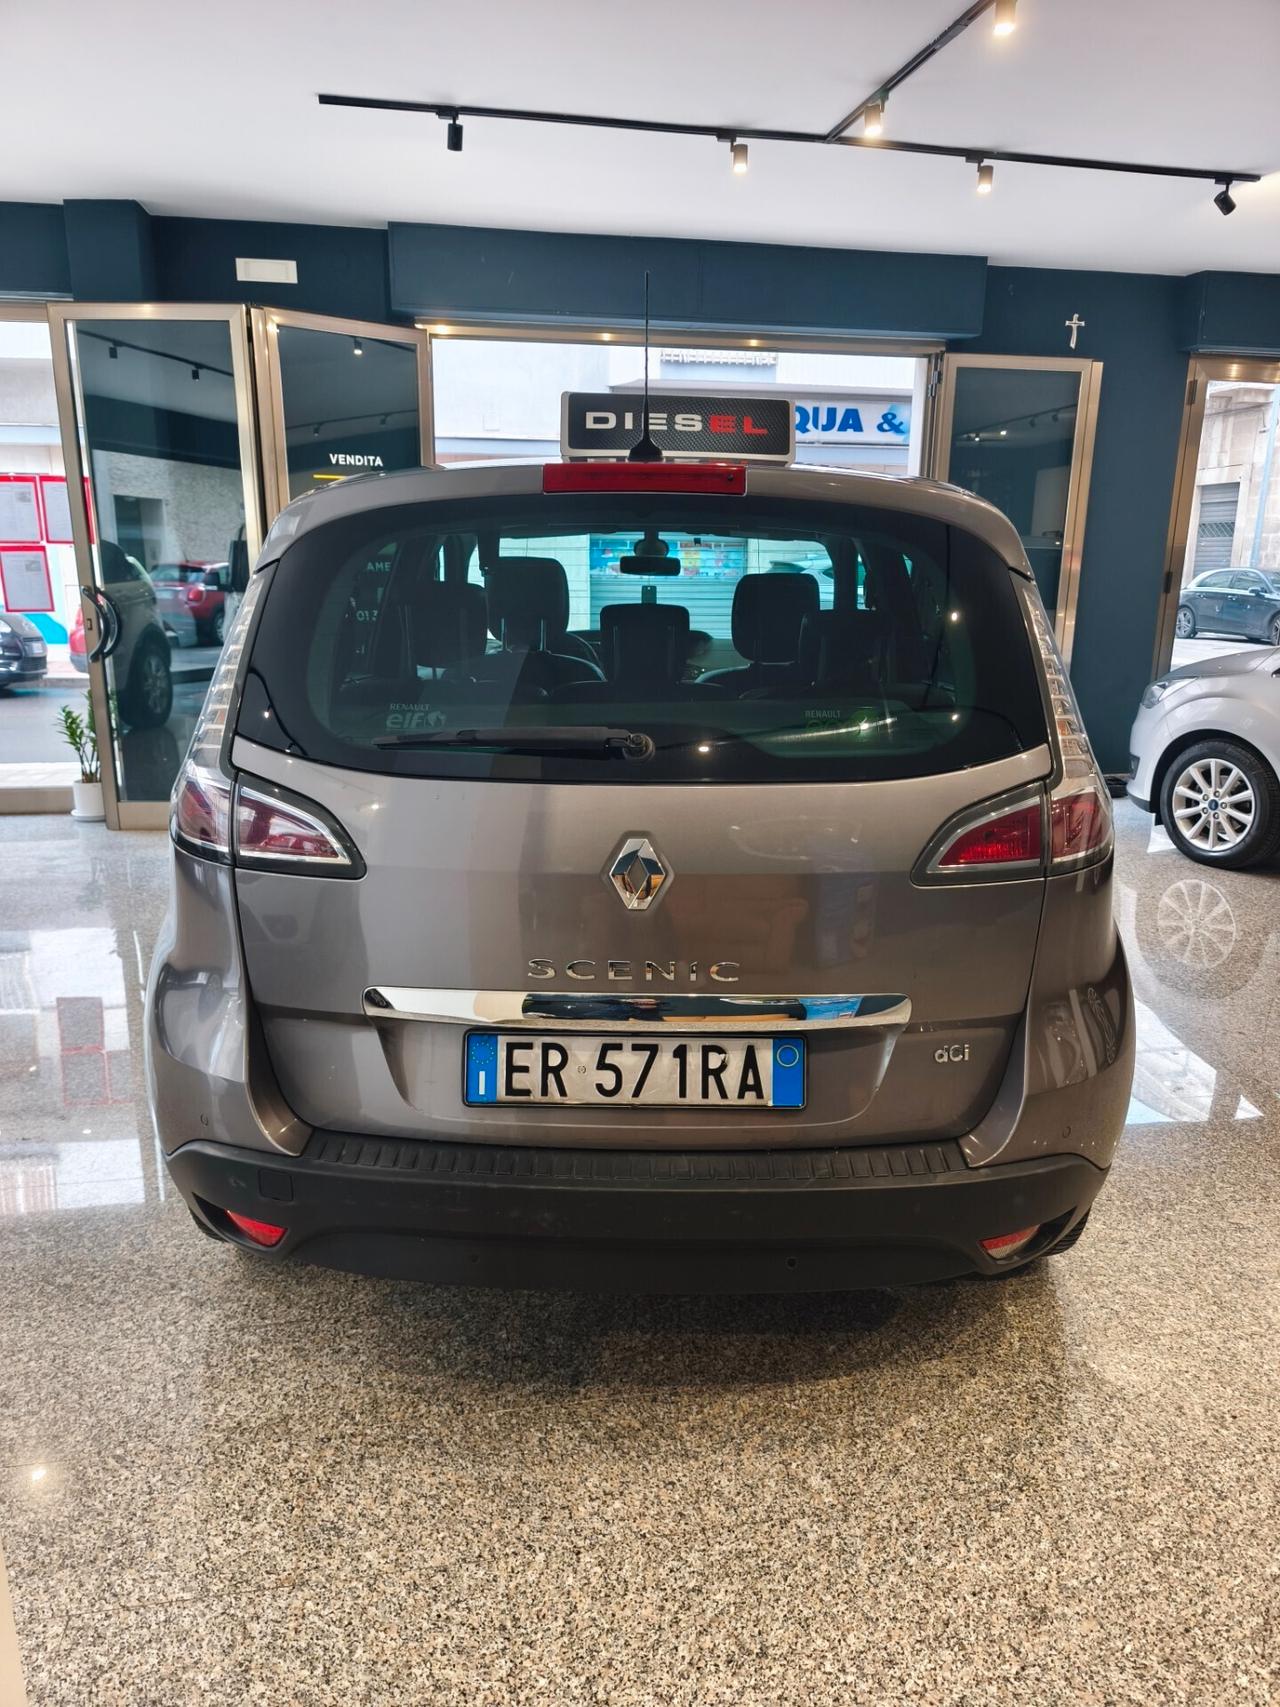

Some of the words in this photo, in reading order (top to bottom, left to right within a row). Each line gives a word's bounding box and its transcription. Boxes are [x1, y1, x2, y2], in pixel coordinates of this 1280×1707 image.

[585, 411, 769, 436] DIESEL
[877, 412, 906, 435] &
[329, 453, 384, 468] VENDITA
[389, 703, 430, 712] RENAULT
[804, 710, 841, 719] RENAULT
[527, 958, 740, 982] SCENIC
[934, 1044, 969, 1064] dCi
[505, 1041, 569, 1098] ER
[595, 1042, 765, 1100] 571RA
